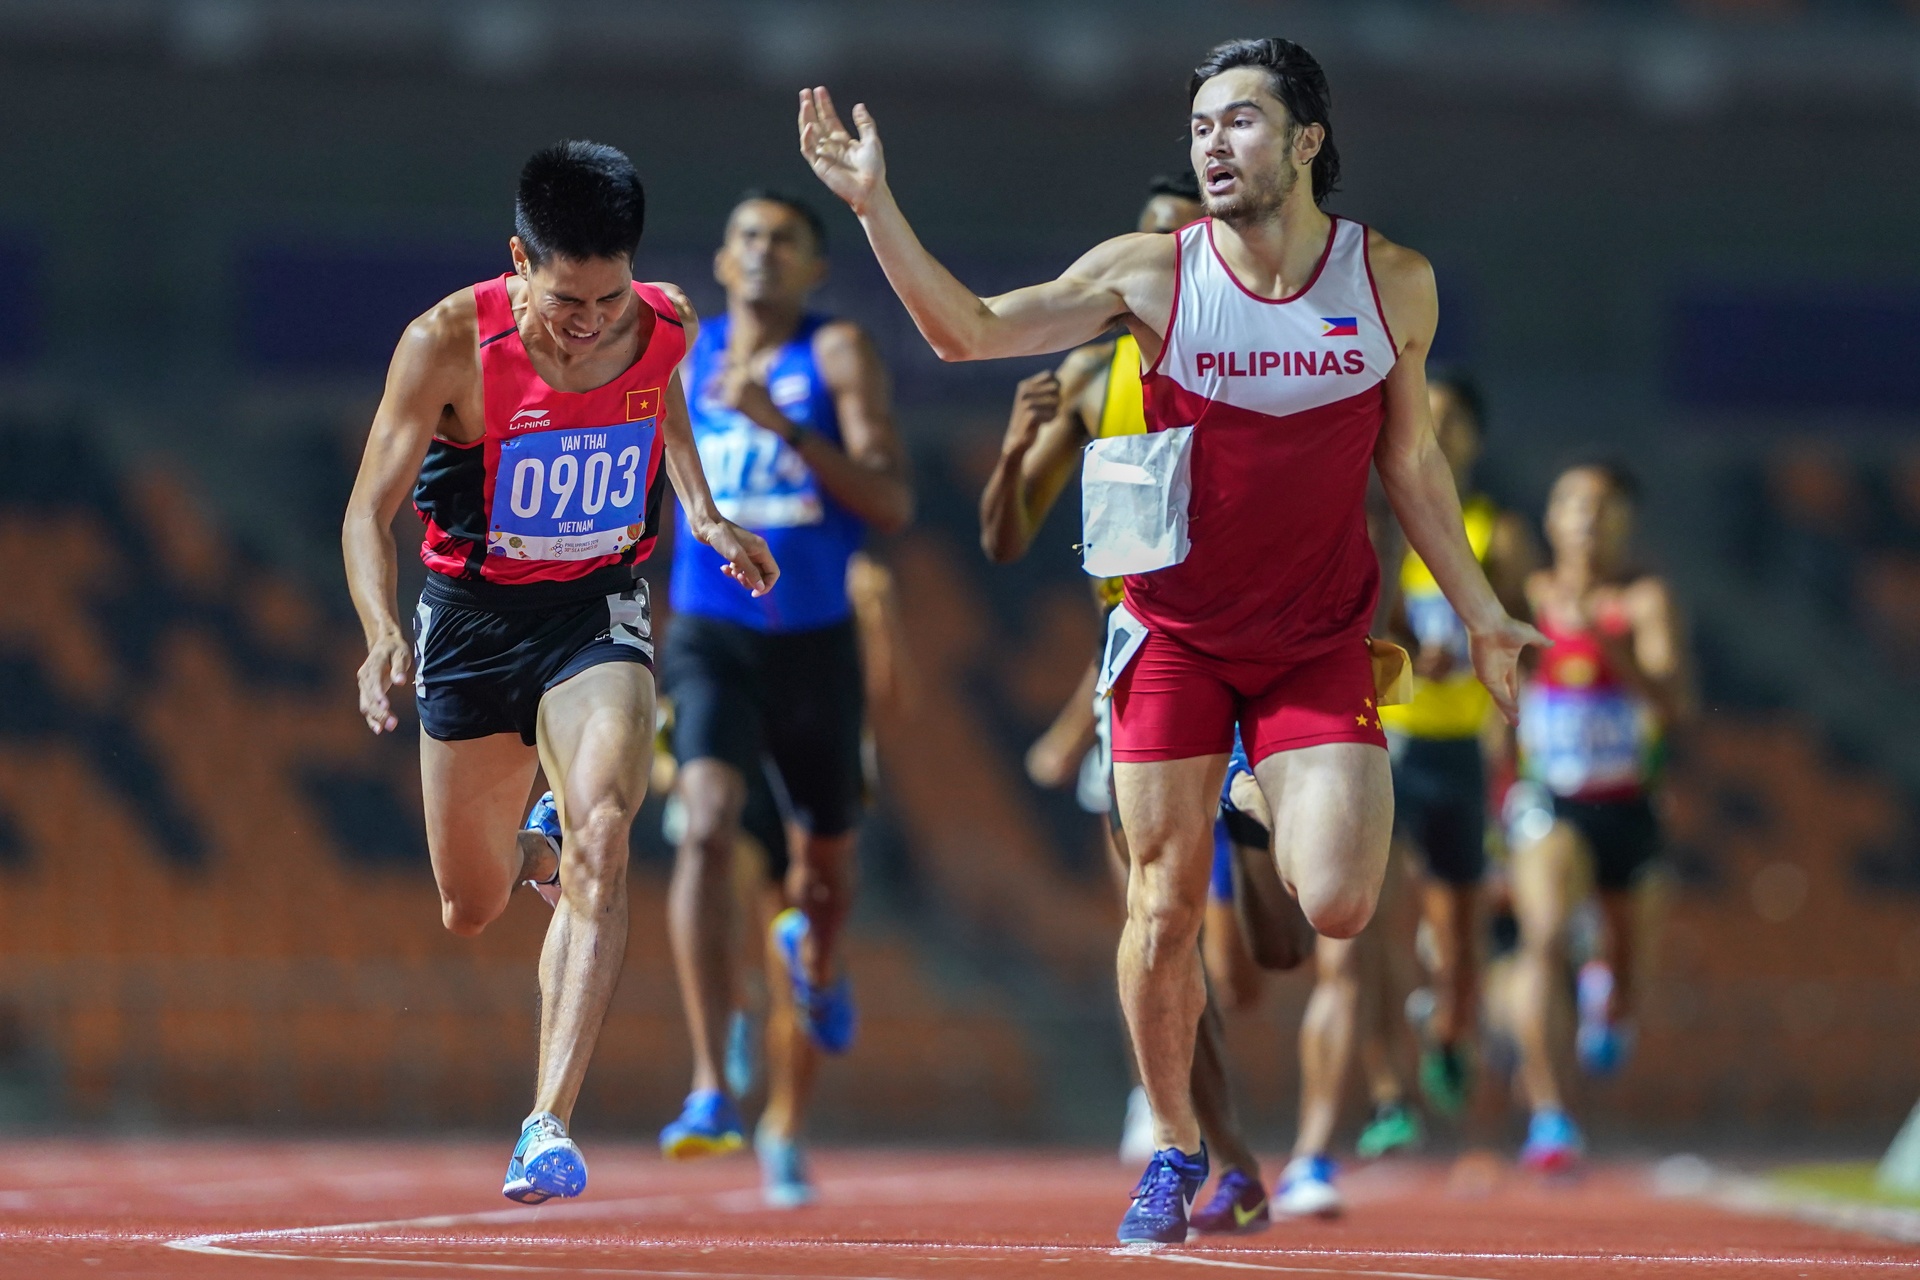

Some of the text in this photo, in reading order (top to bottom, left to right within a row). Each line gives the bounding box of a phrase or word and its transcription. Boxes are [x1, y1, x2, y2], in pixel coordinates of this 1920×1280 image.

[1195, 349, 1366, 378] PILIPINAS
[509, 419, 551, 430] LI-NING
[561, 433, 607, 452] VAN THAI
[510, 445, 641, 519] 0903
[558, 518, 594, 533] VIETNAM
